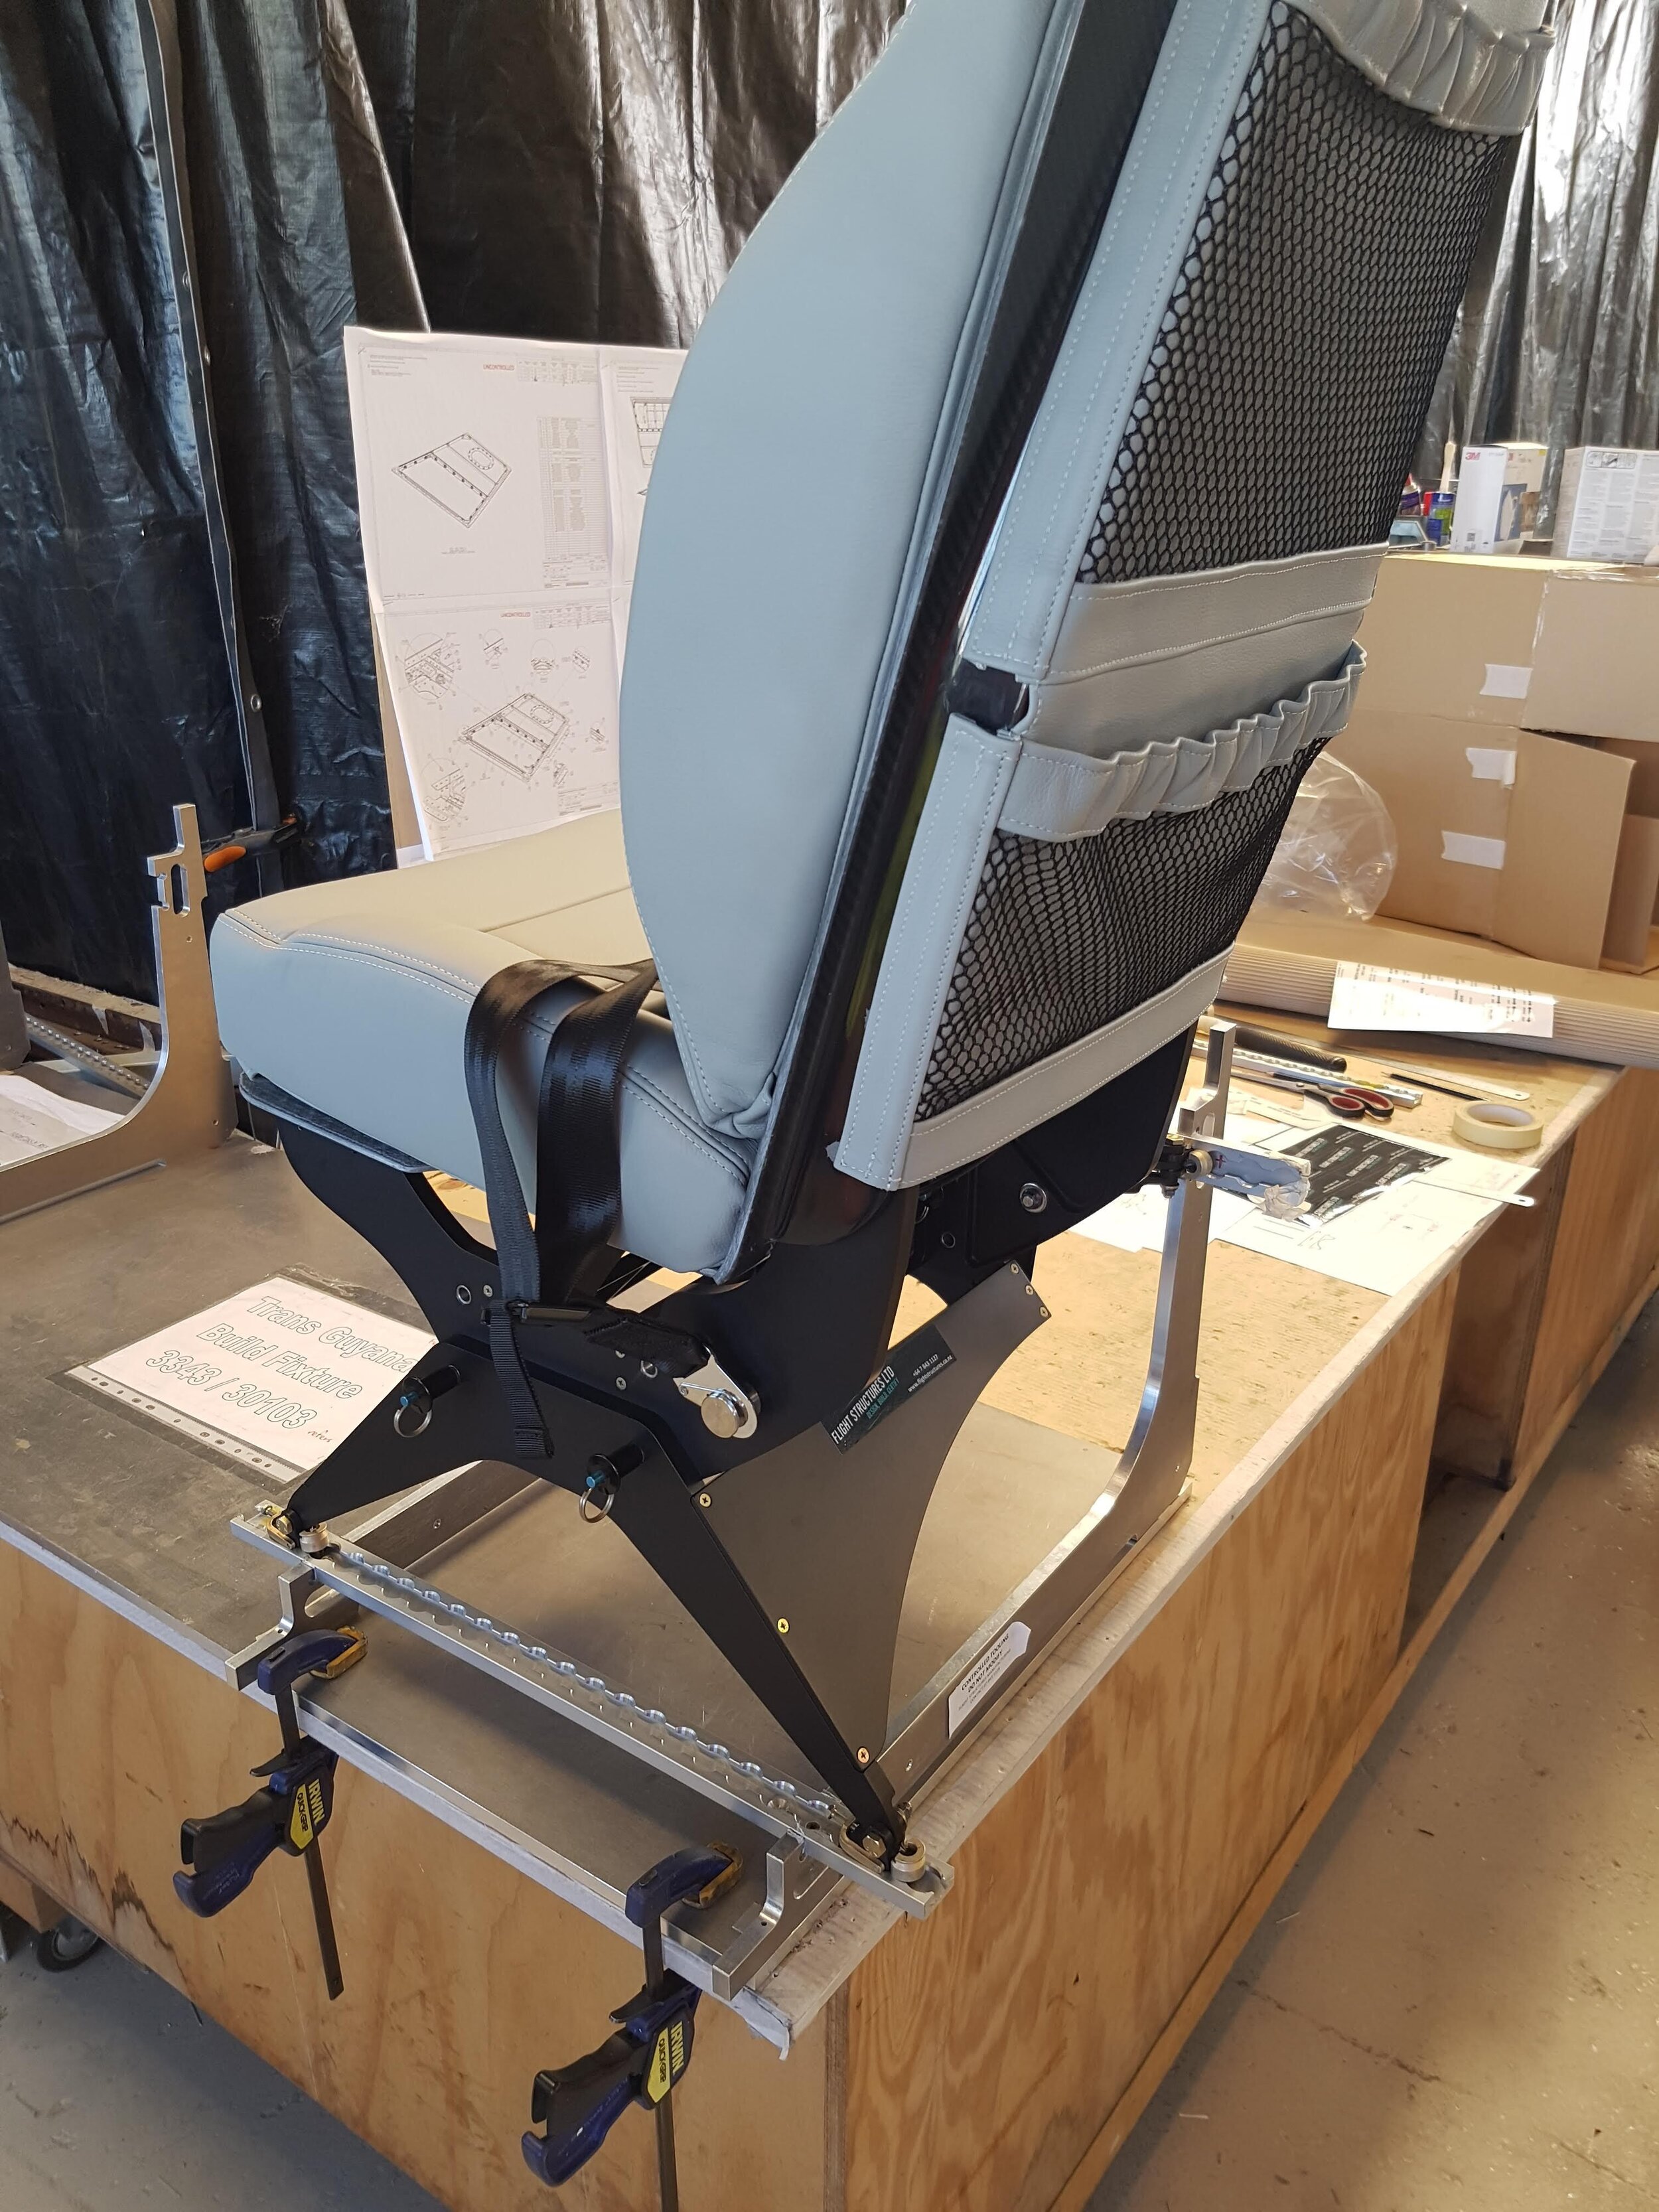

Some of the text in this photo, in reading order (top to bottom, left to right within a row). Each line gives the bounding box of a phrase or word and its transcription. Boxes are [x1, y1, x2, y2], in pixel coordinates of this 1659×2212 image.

[1465, 452, 1480, 461] 3M
[196, 1323, 362, 1399] Build Fixture
[246, 1296, 419, 1373] Trans Guyana
[146, 1350, 222, 1386] 3343
[222, 1383, 317, 1430] 30103
[831, 1365, 895, 1444] FLIGHT STRUCTURES LTD
[962, 1655, 989, 1691] CONTROLLED
[990, 1633, 1009, 1658] TOOLING
[968, 1651, 1003, 1693] DO NOT MODIFY
[309, 1778, 325, 1826] IRWIN
[670, 2020, 684, 2076] IRWIN
